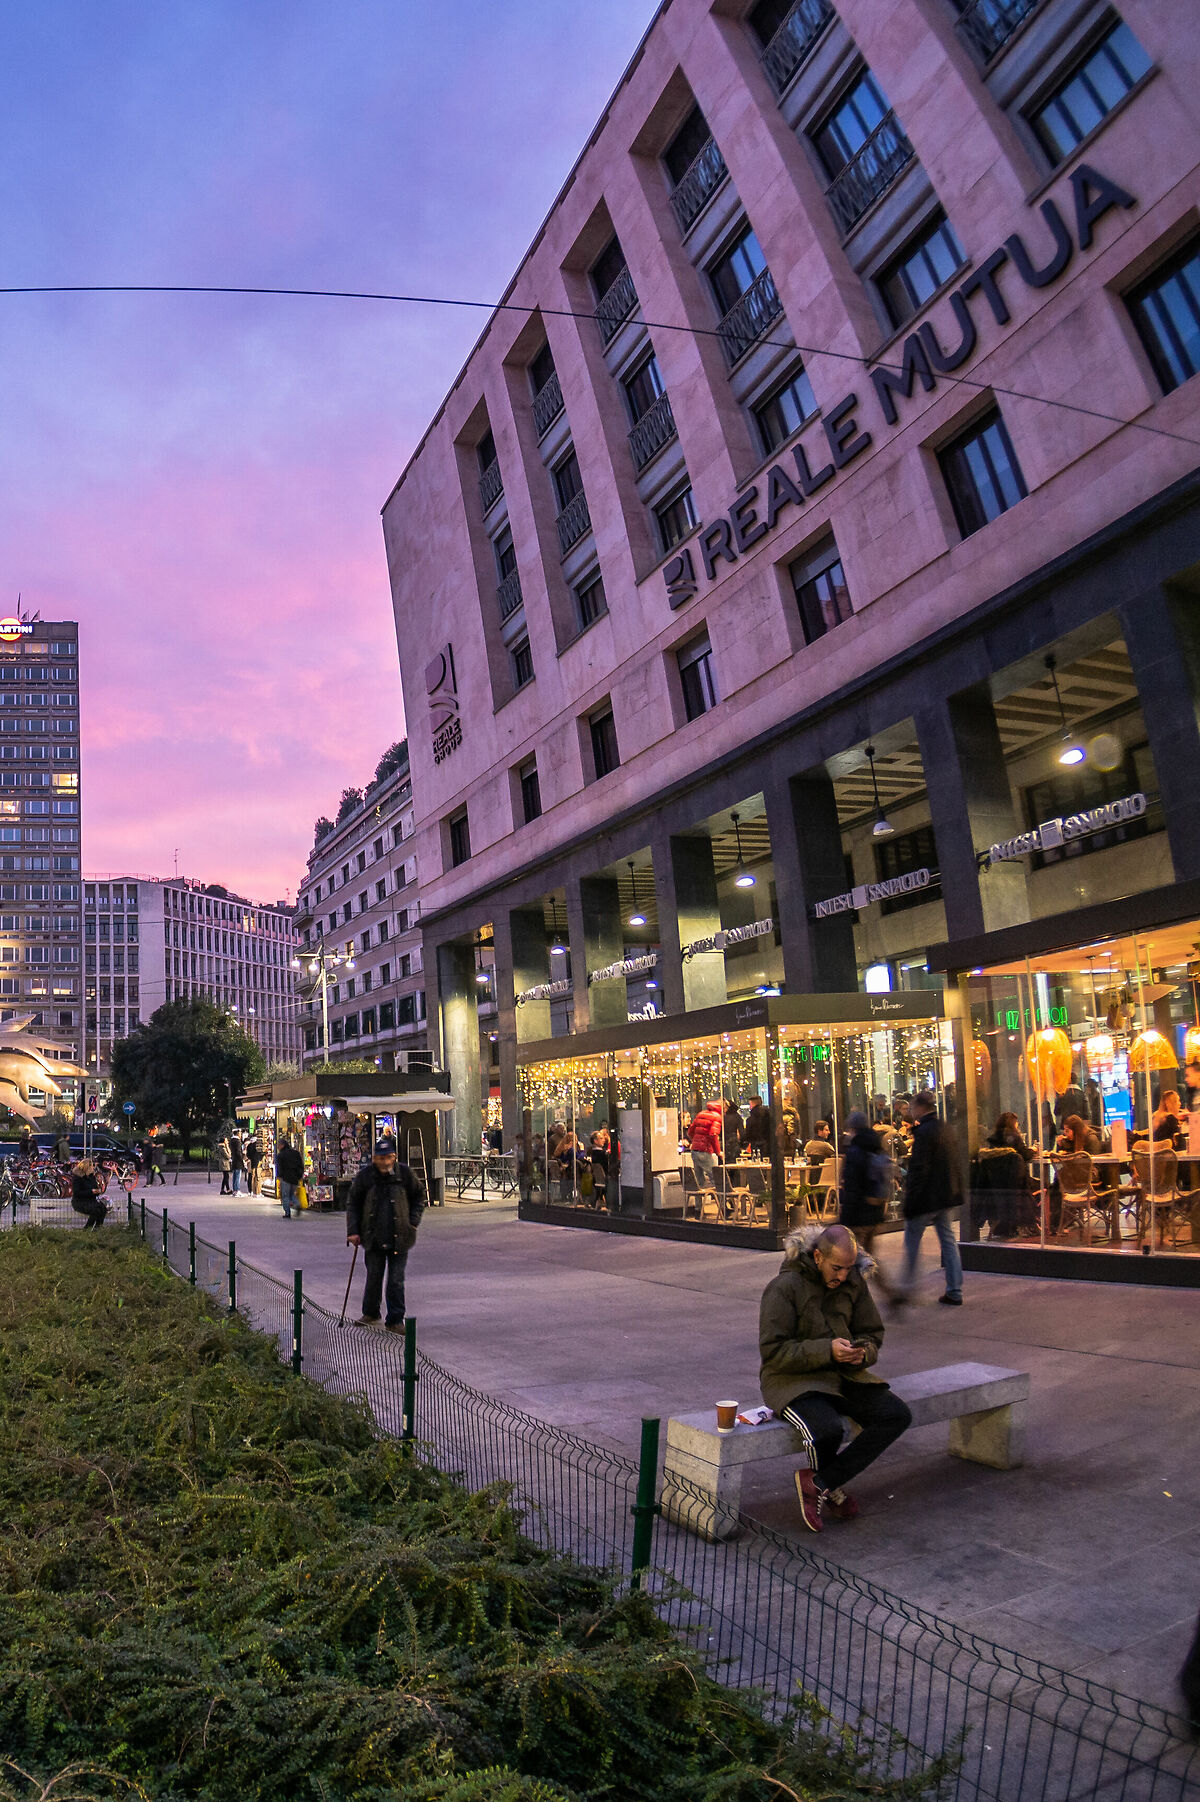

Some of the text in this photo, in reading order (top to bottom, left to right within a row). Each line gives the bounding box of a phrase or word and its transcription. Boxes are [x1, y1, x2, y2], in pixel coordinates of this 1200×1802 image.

[698, 163, 1137, 580] REALE MUTUA
[432, 718, 462, 754] REALE
[868, 868, 931, 901] SANPAOLO
